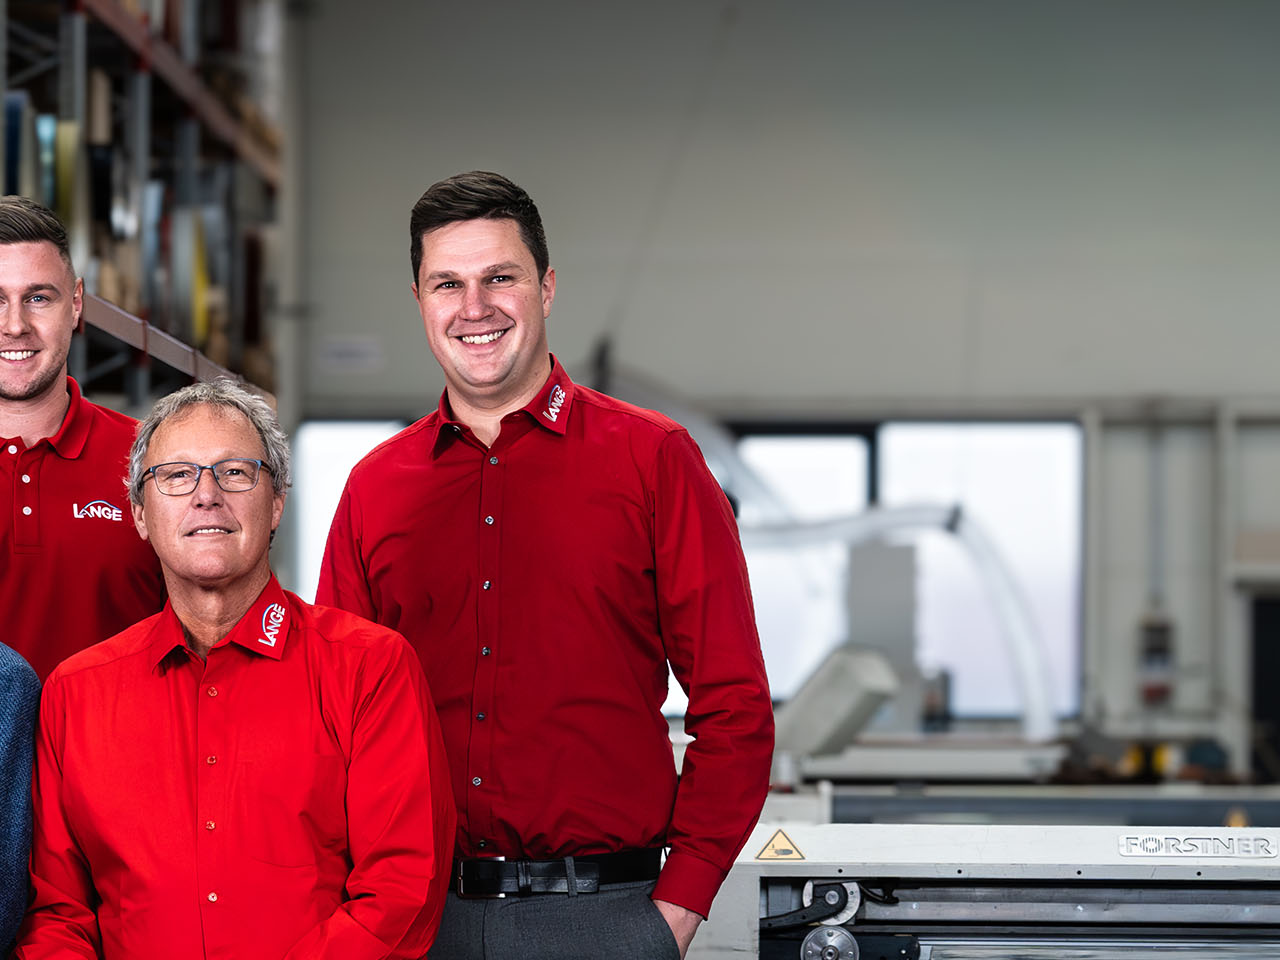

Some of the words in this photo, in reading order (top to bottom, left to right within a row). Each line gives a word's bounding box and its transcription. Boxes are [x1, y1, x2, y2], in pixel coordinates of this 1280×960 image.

[542, 387, 566, 422] LANGE
[73, 502, 123, 521] LANGE
[258, 603, 286, 647] LANGE
[1125, 836, 1272, 855] FORSTNER
